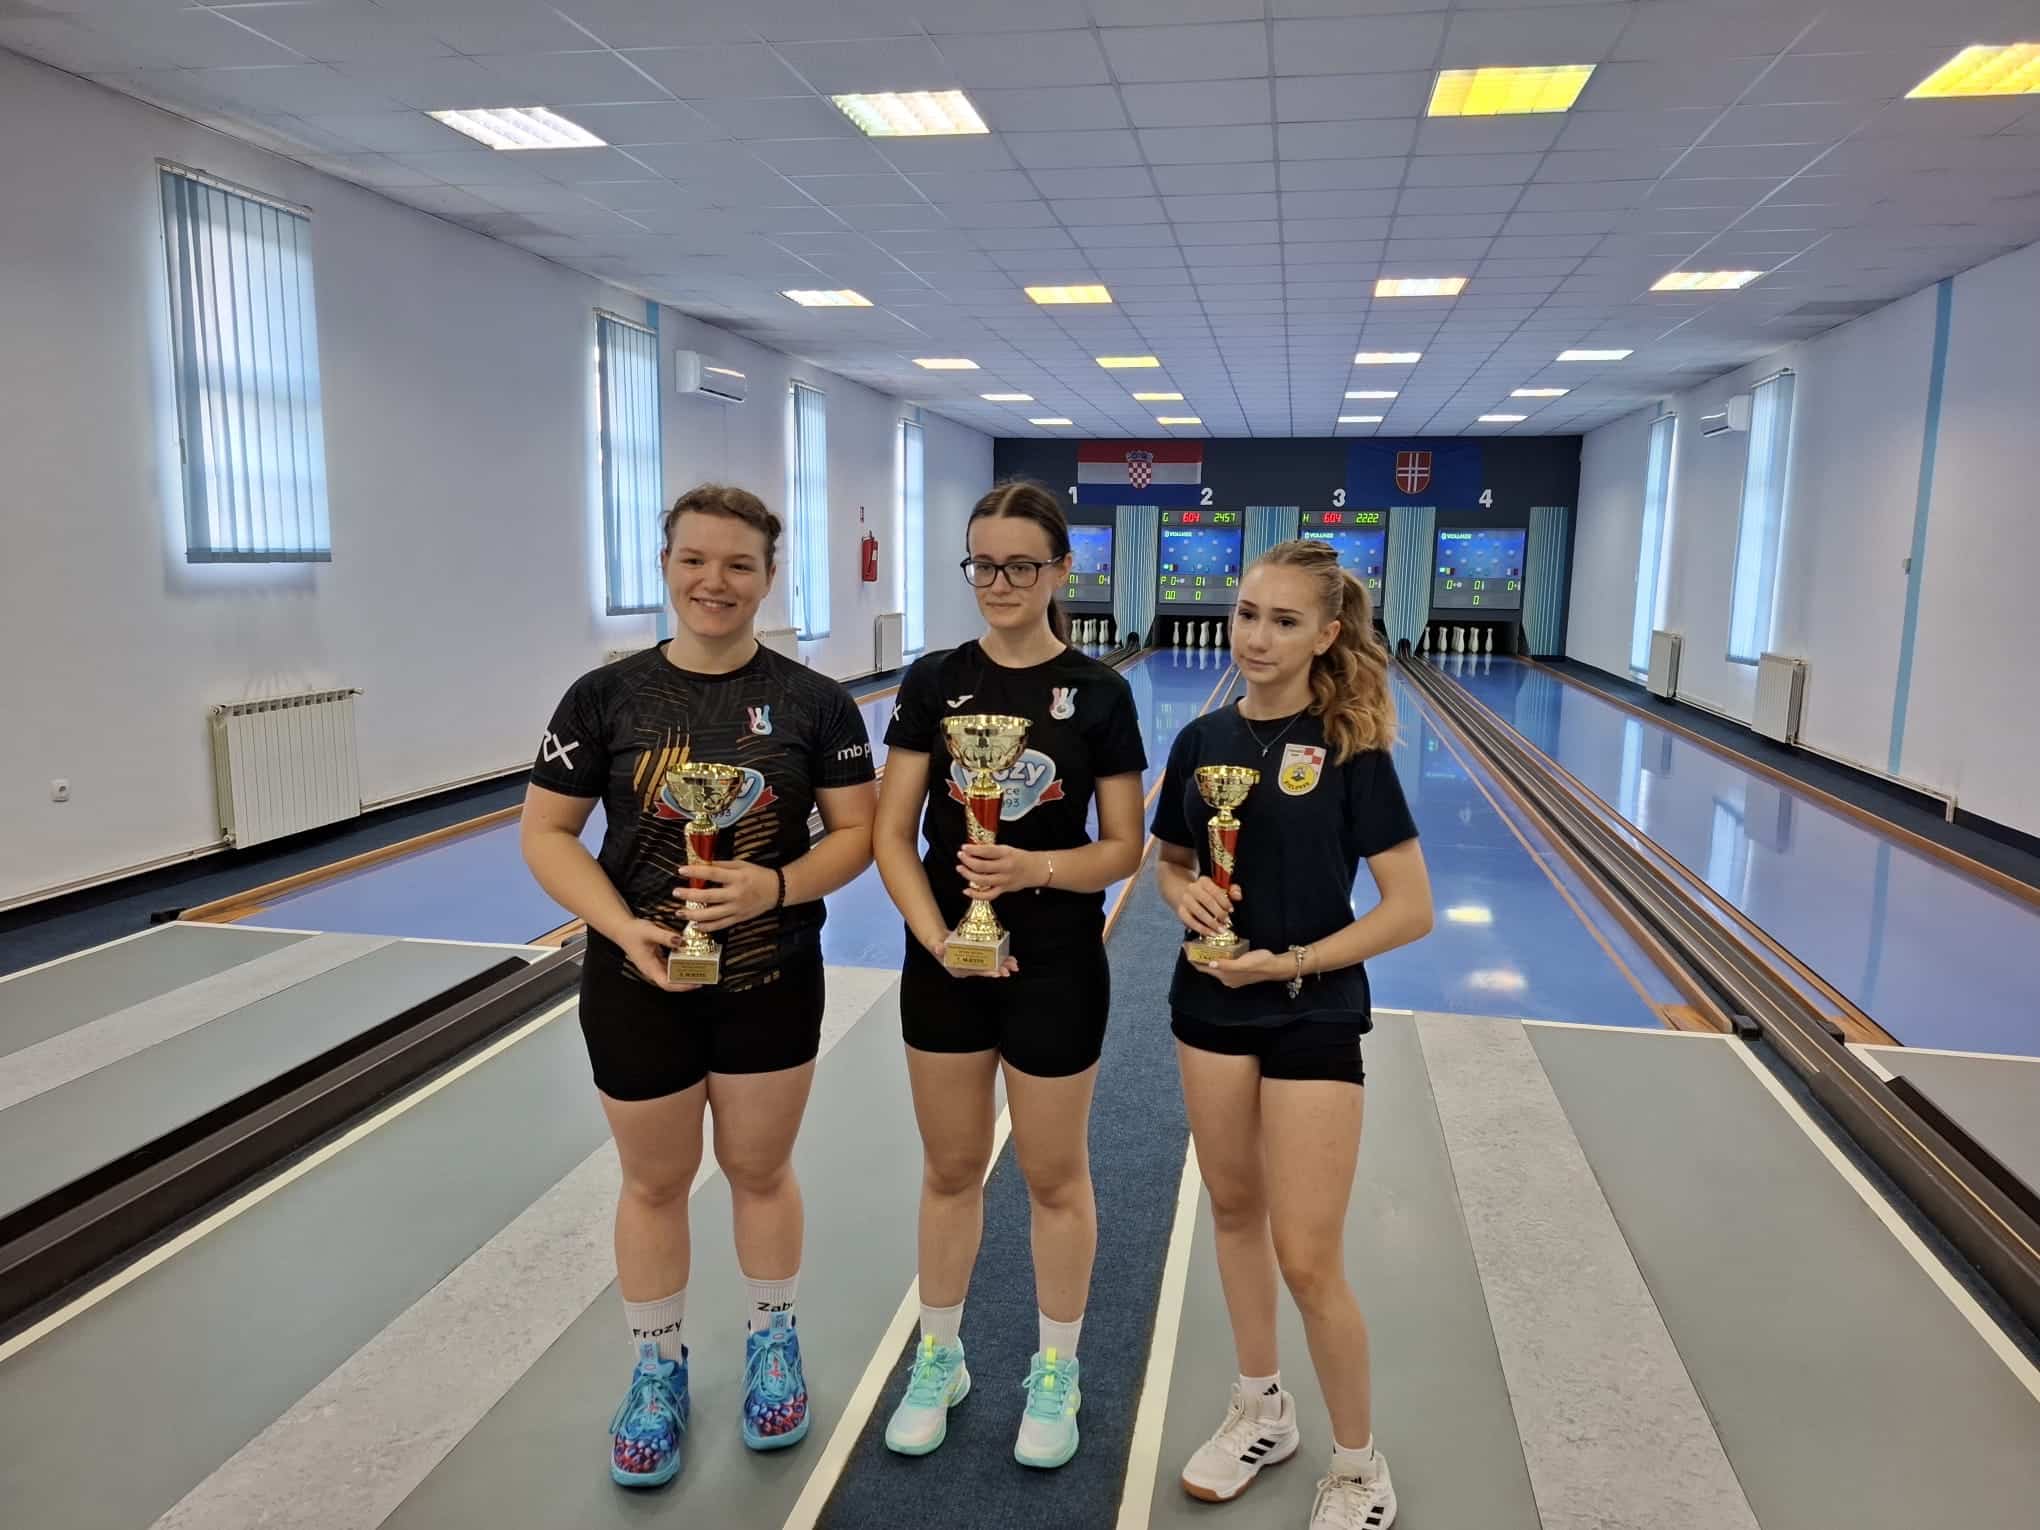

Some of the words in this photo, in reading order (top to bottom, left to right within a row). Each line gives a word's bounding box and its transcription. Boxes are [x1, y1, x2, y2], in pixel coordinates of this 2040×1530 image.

[1068, 486, 1078, 504] 1
[1200, 487, 1213, 506] 2
[1333, 488, 1346, 507] 3
[1478, 489, 1493, 508] 4
[1213, 512, 1236, 523] 2457
[1356, 513, 1379, 523] 2222
[837, 744, 863, 761] mb
[757, 1302, 793, 1312] Zab
[633, 1318, 682, 1338] Frozy
